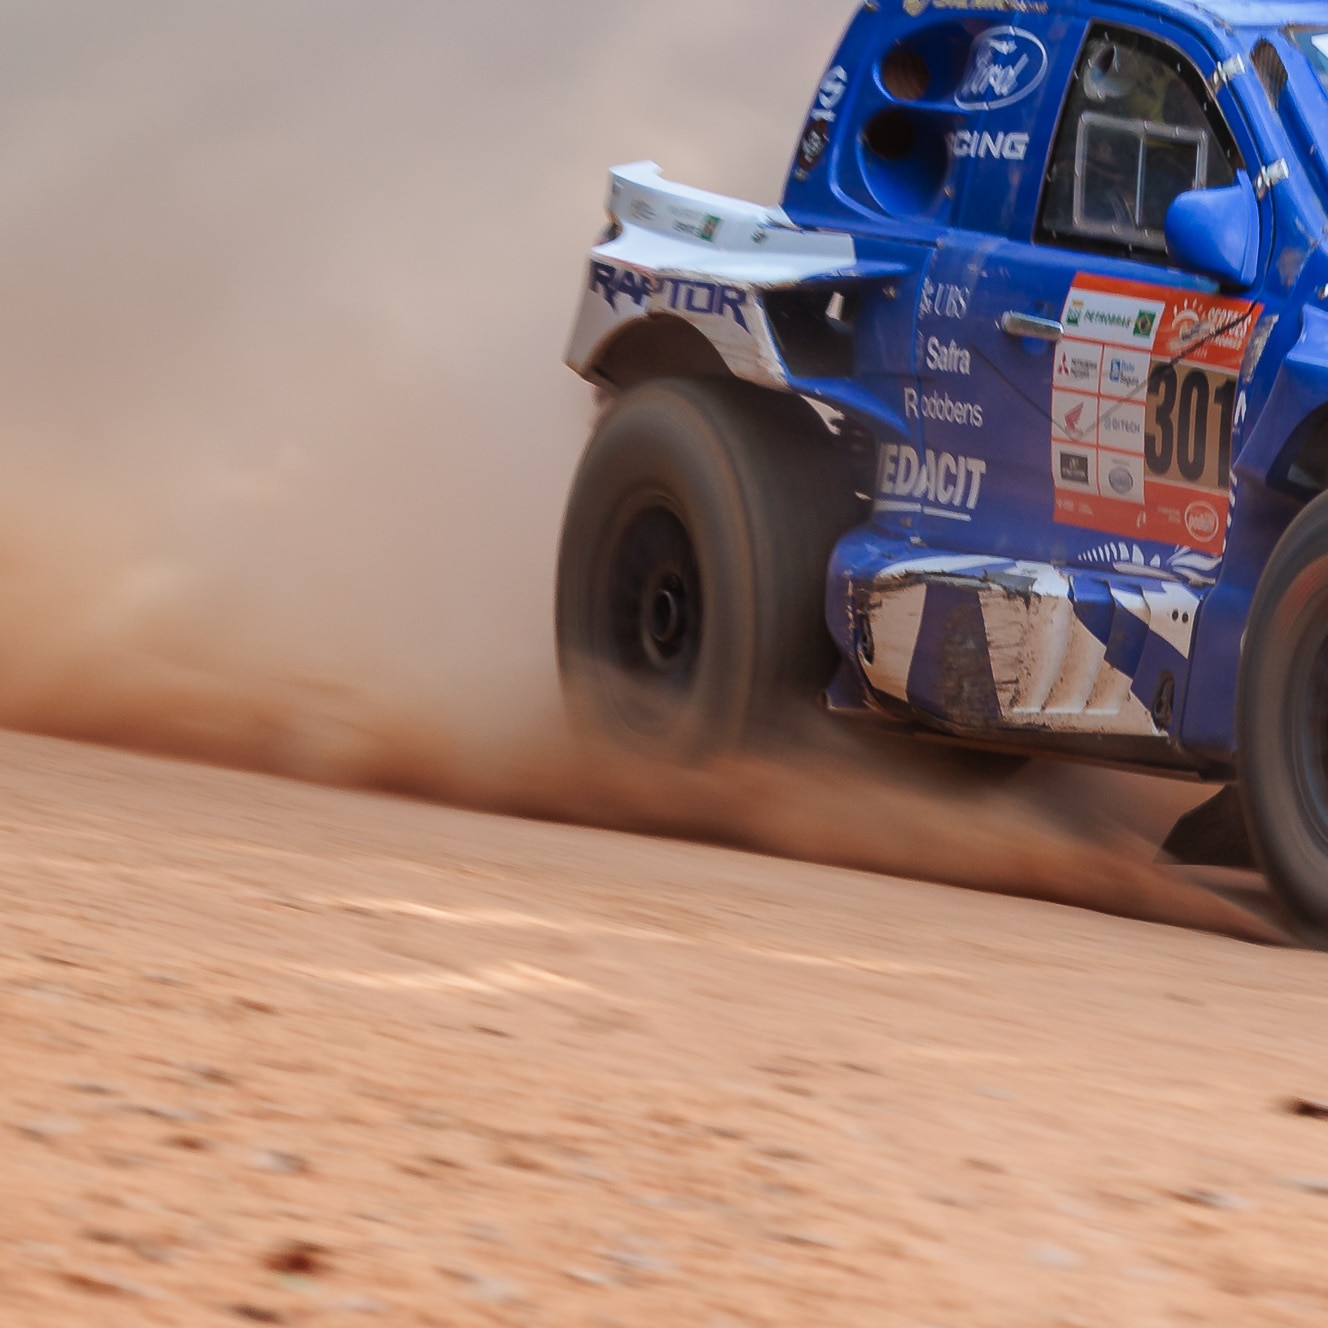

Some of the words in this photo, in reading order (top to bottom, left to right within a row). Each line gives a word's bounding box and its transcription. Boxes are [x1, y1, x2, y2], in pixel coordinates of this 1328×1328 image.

[589, 258, 751, 335] RAPTOR
[926, 335, 971, 375] Safra
[1144, 363, 1238, 489] 301
[878, 443, 987, 510] EDACIT
